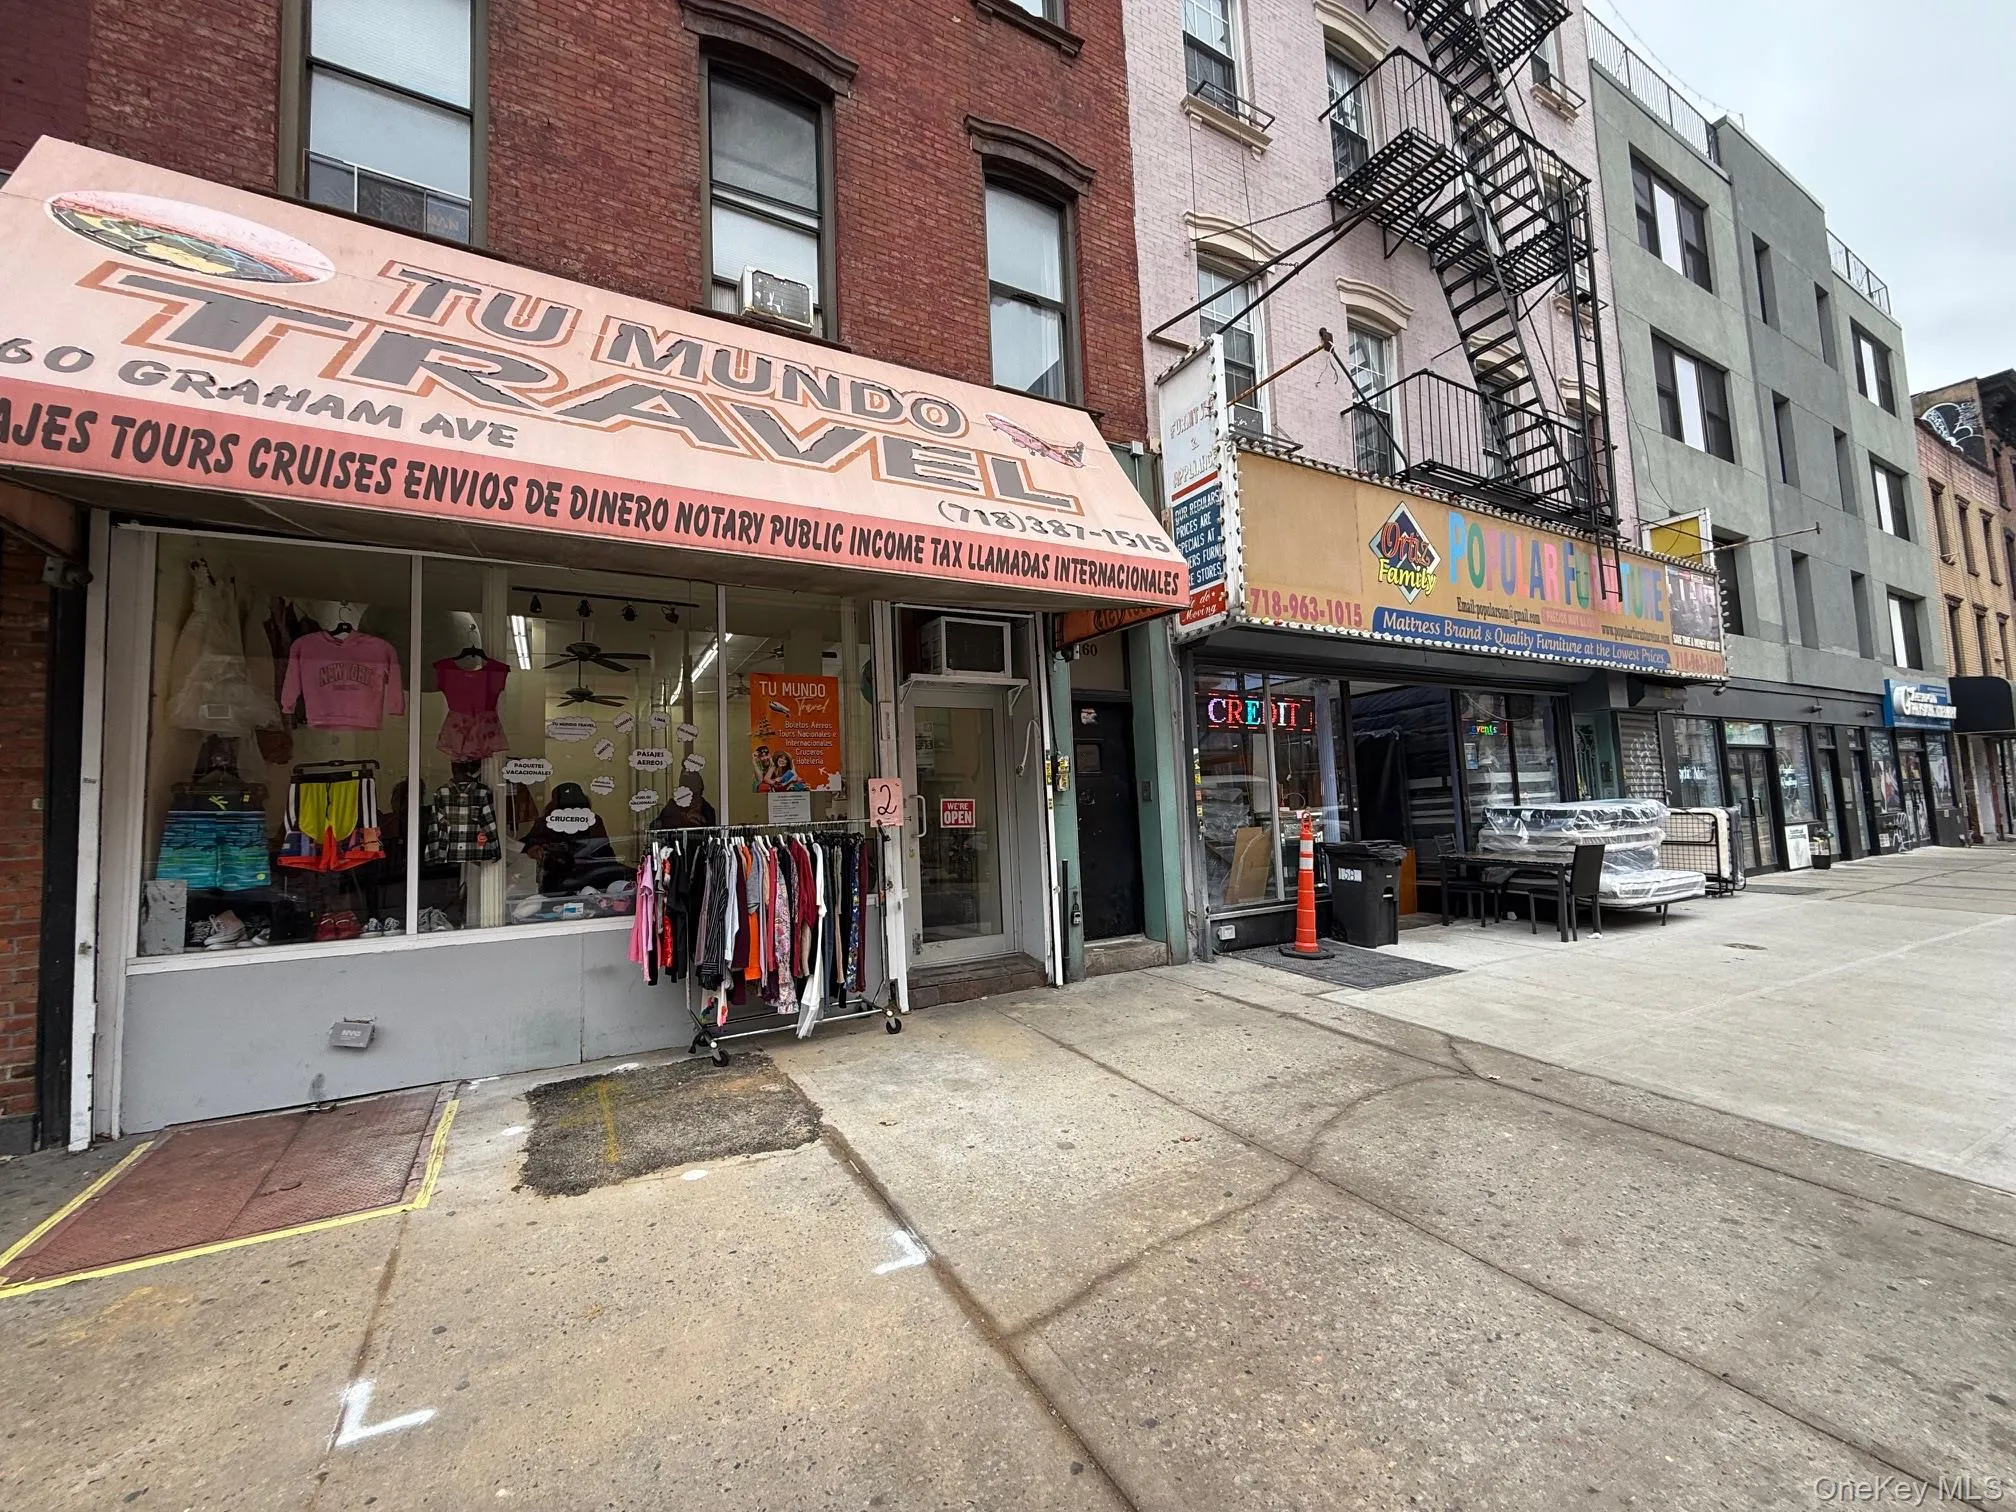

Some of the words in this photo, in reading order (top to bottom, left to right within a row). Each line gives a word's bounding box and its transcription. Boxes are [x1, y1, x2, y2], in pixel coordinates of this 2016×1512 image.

[378, 259, 582, 347] TU
[592, 314, 969, 439] MUNDO
[75, 260, 1087, 517] TRAVEL
[118, 360, 403, 428] GRAHAM
[420, 413, 518, 448] AVE
[111, 415, 240, 475] TOURS
[248, 437, 397, 495] CRUISES
[404, 460, 518, 510] ENVIOS
[525, 478, 563, 518] DE
[569, 485, 669, 532] DINERO
[675, 501, 765, 544] NOTARY
[770, 514, 843, 554] PUBLIC
[849, 525, 924, 563] INCOME
[931, 539, 962, 569] TAX
[968, 543, 1050, 580] LLAMADAS
[1054, 555, 1179, 596] INTERNACIONALES
[1175, 502, 1189, 525] OUR
[938, 500, 1170, 553] (718)387-1515
[1176, 519, 1198, 541] PRICES
[1200, 511, 1212, 531] ARE
[1178, 532, 1205, 555] SPECIALS
[1207, 527, 1216, 546] AT
[1448, 511, 1559, 602] POPULAR
[1378, 558, 1437, 597] Family
[1249, 588, 1363, 628] 718-963-1015
[1383, 611, 1441, 635] Mattress
[1444, 620, 1482, 640] Brand
[1485, 629, 1492, 641] &
[1495, 627, 1534, 650] Quality
[1536, 633, 1582, 654] Furniture
[1585, 641, 1594, 656] at
[1597, 644, 1611, 657] the
[1612, 645, 1639, 660] Lowest
[760, 681, 777, 696] TU
[782, 682, 826, 698] MUNDO
[794, 696, 830, 716] Travel
[1207, 698, 1301, 727] CREDIT
[779, 729, 796, 738] Tours
[797, 730, 831, 738] Nacionales
[785, 720, 809, 729] Boletos
[785, 740, 833, 748] Internacionales
[795, 748, 824, 757] Cruceros
[550, 815, 589, 824] CRUCEROS
[944, 811, 972, 824] OPEN
[948, 802, 969, 810] WE'RE
